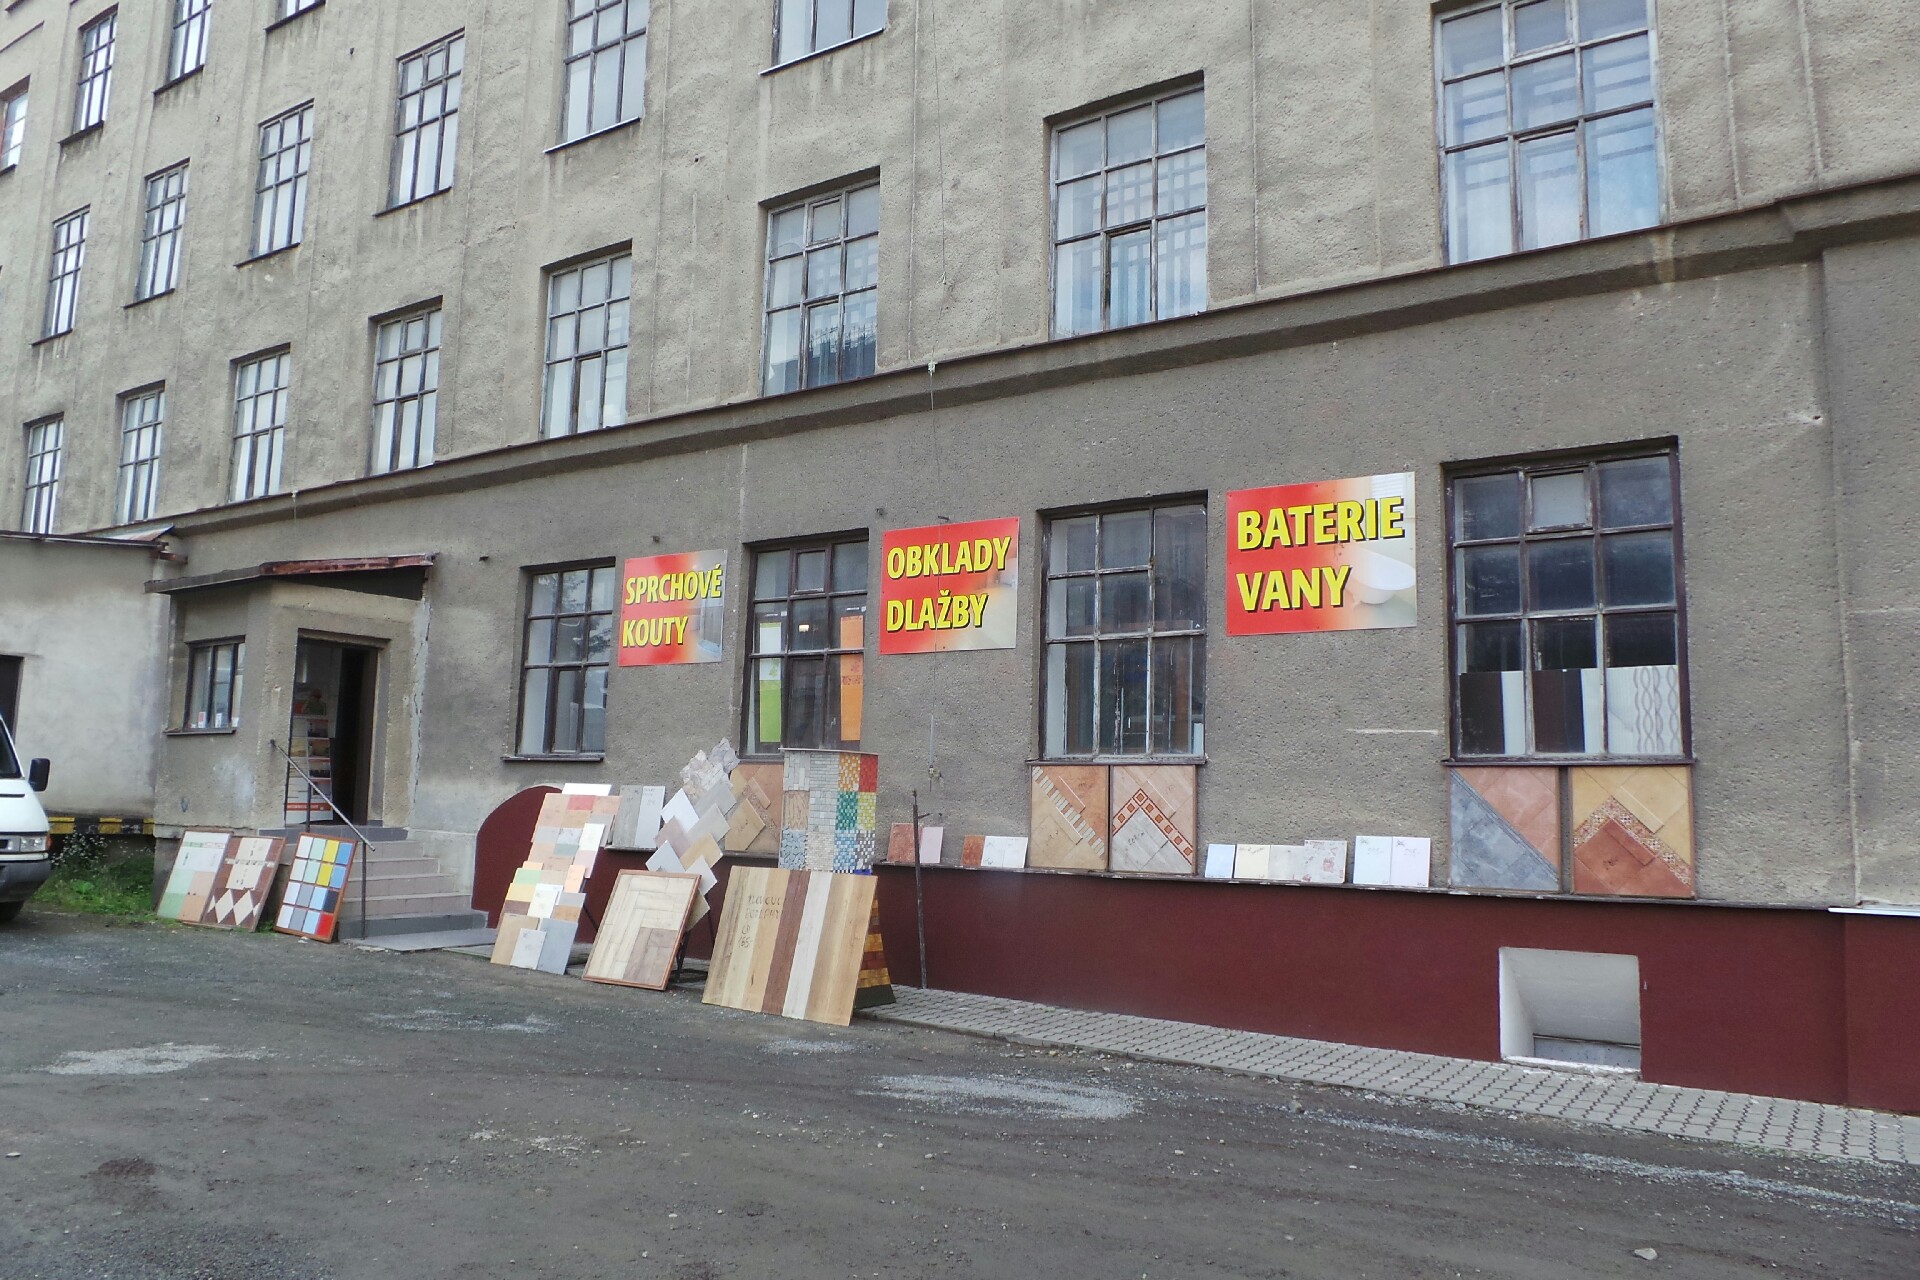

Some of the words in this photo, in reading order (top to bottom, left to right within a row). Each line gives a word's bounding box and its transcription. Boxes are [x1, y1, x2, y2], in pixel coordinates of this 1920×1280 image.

[1236, 495, 1406, 550] BATERIE
[887, 536, 1012, 579] OBKLADY
[625, 564, 723, 605] SPRCHOVÉ
[1236, 565, 1351, 611] VANY
[622, 615, 689, 648] KOUTY
[886, 591, 988, 632] DLAŽBY
